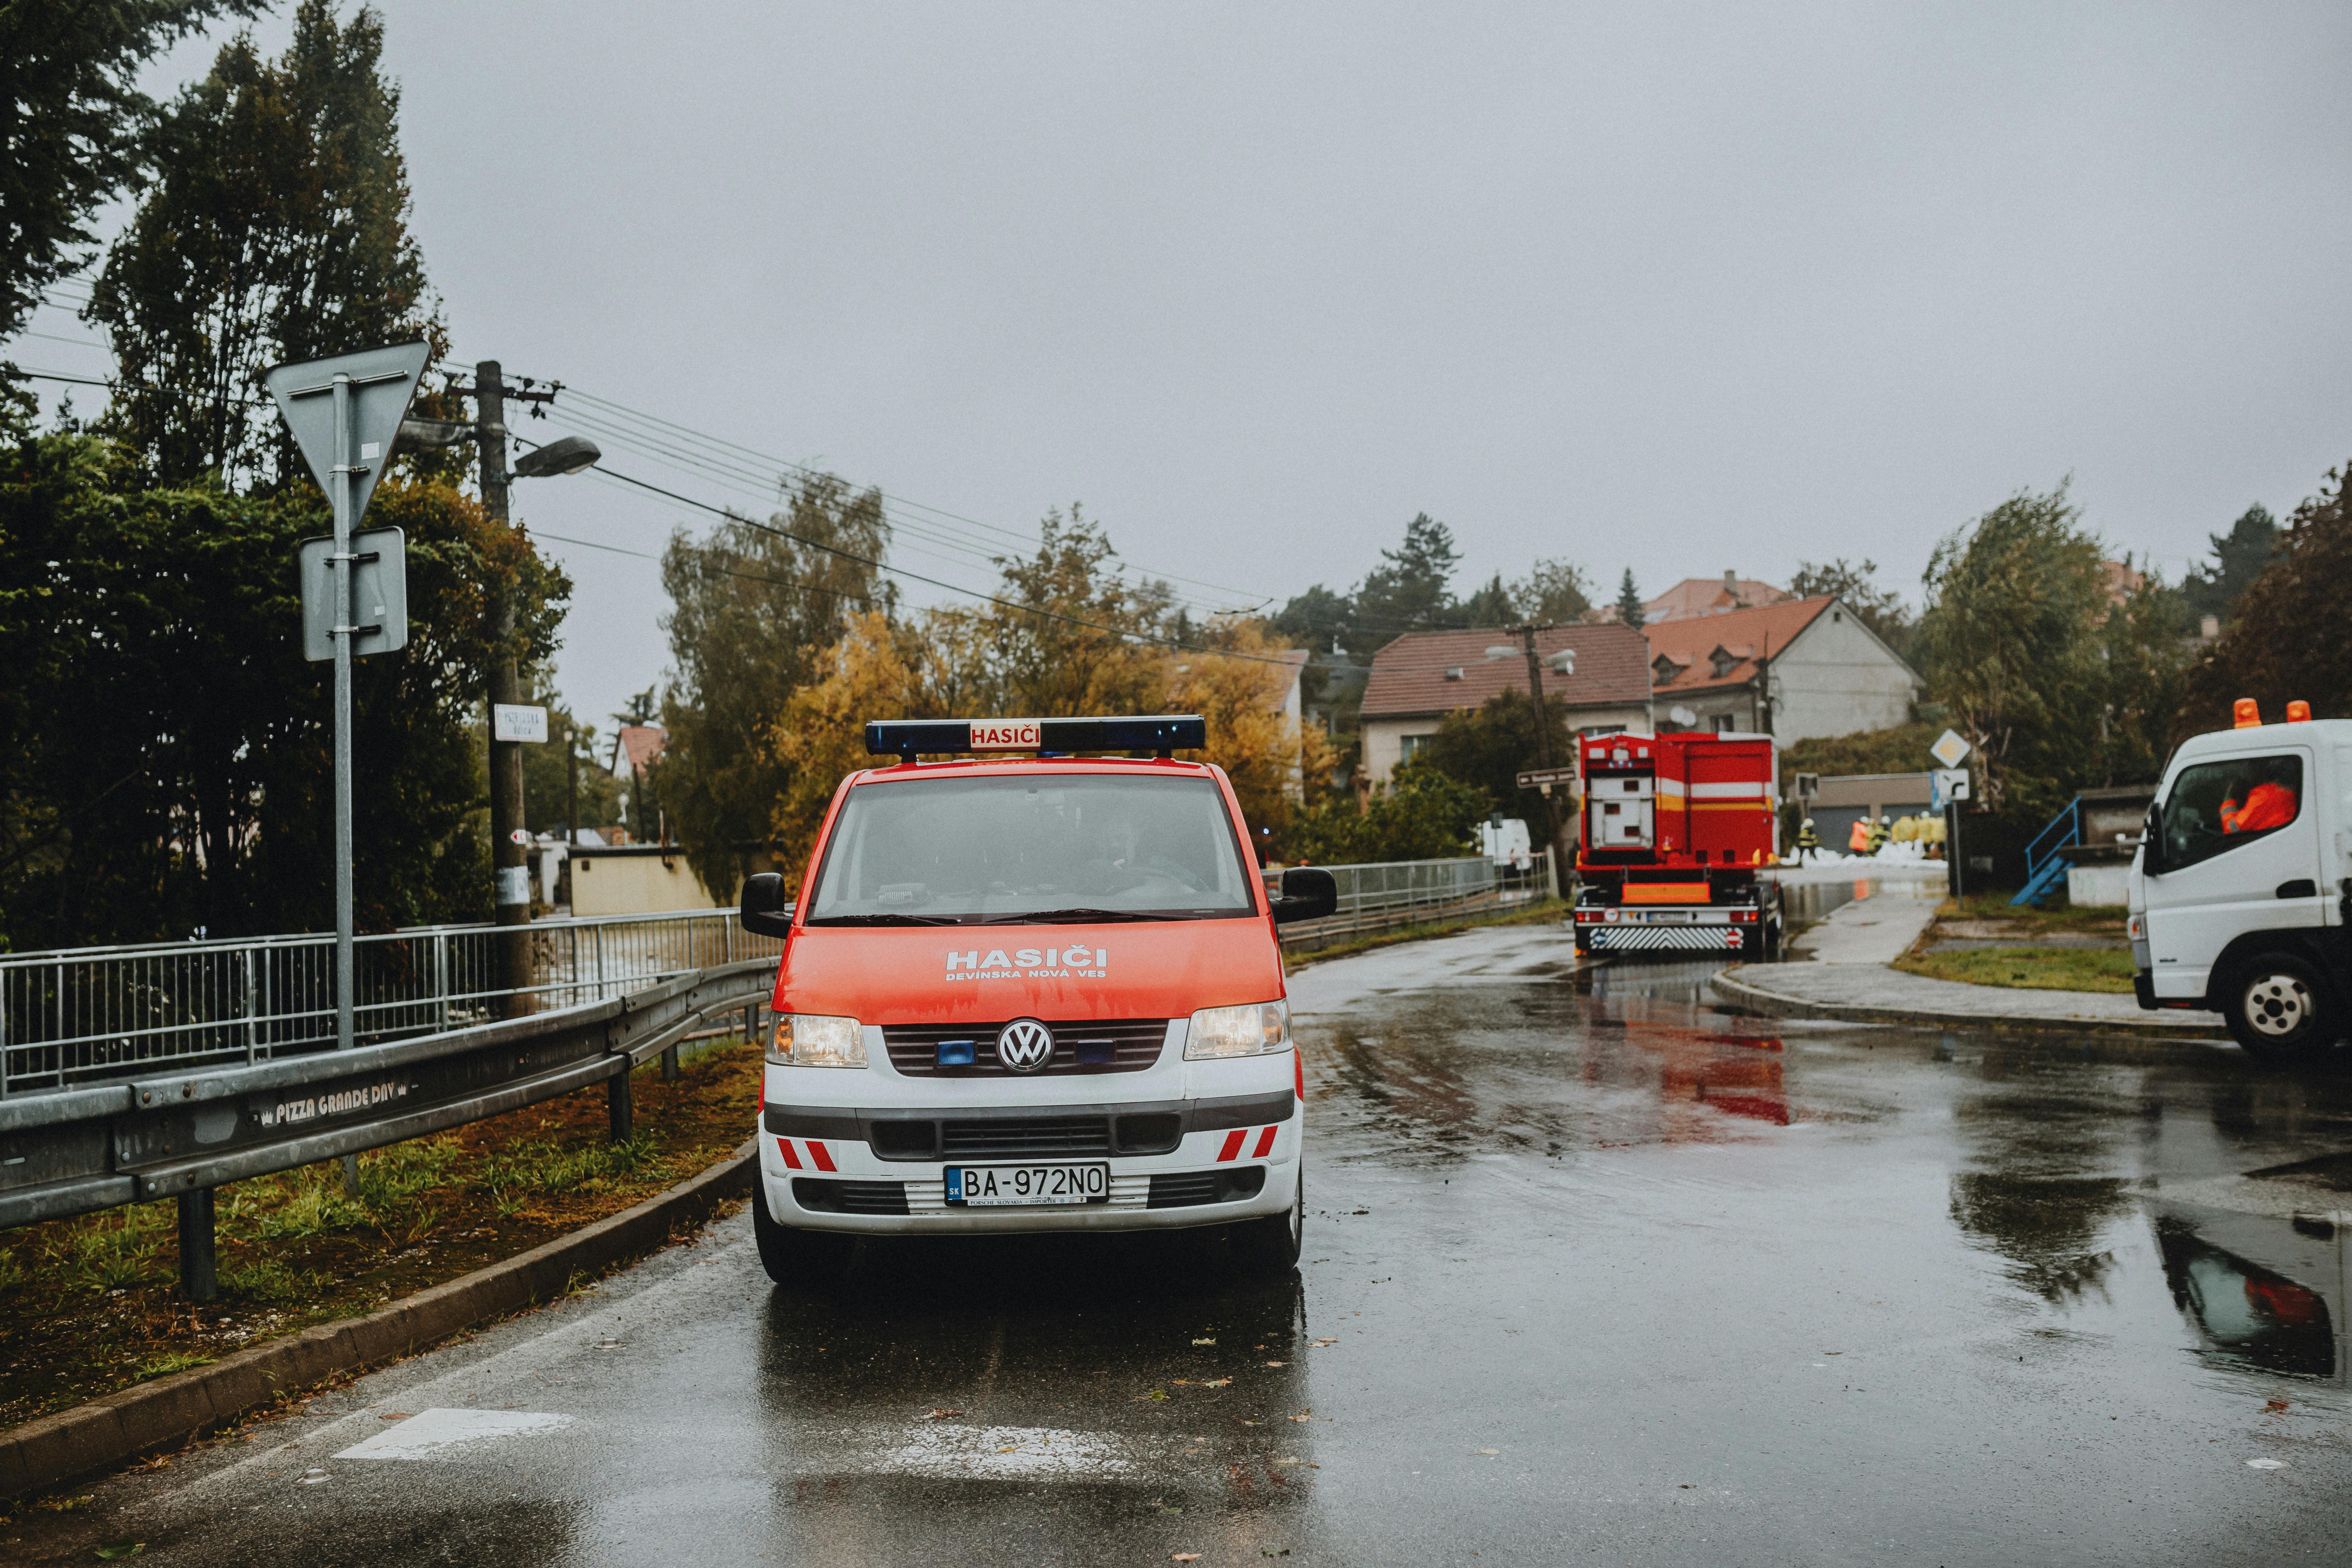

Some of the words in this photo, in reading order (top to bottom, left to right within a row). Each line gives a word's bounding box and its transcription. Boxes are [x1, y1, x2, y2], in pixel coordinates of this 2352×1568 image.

[972, 724, 1039, 743] HASIČI
[945, 944, 1107, 970] HASIČI
[945, 970, 1021, 981] DEVÍNSKA
[1028, 968, 1070, 978] NOVÁ
[276, 1098, 314, 1124] PIZZA
[318, 1087, 368, 1115] GRANDE
